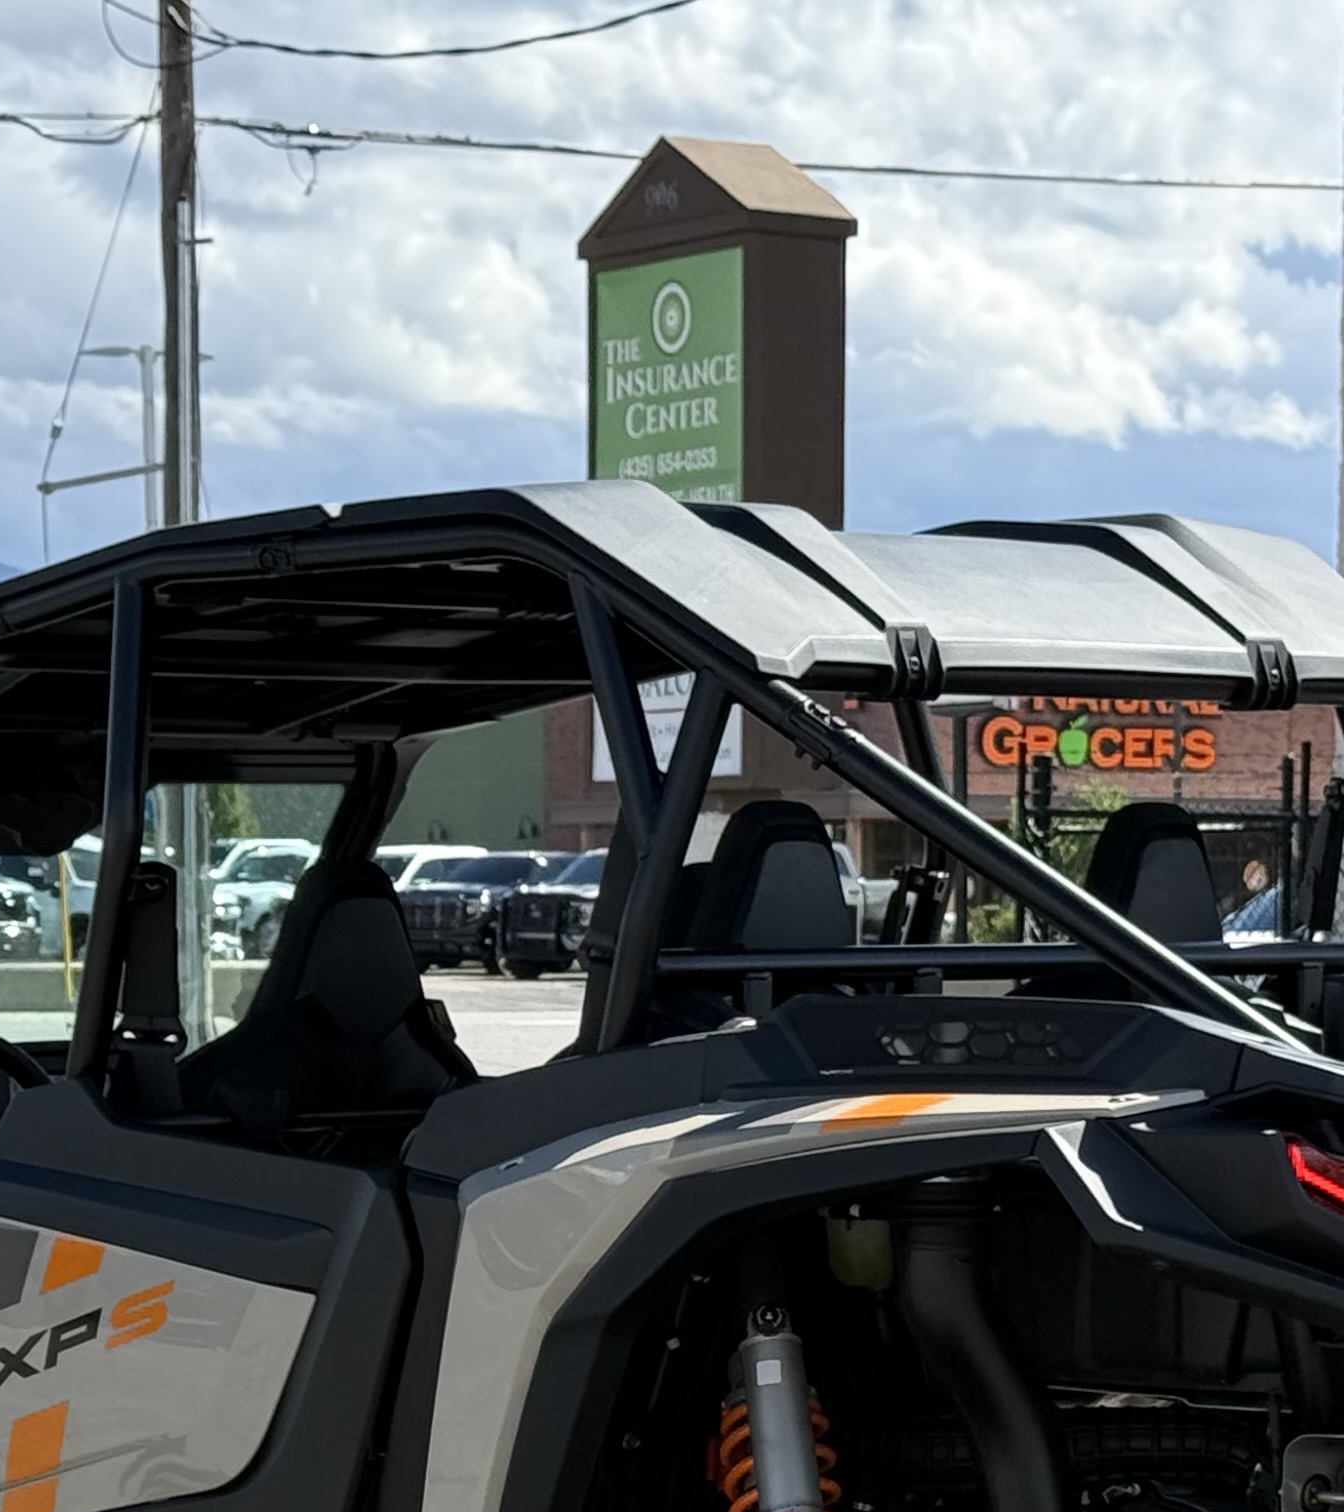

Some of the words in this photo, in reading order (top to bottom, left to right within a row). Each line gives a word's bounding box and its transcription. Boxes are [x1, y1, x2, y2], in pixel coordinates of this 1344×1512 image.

[603, 337, 641, 365] THE
[607, 353, 738, 404] INSURANCE
[625, 397, 719, 439] CENTER
